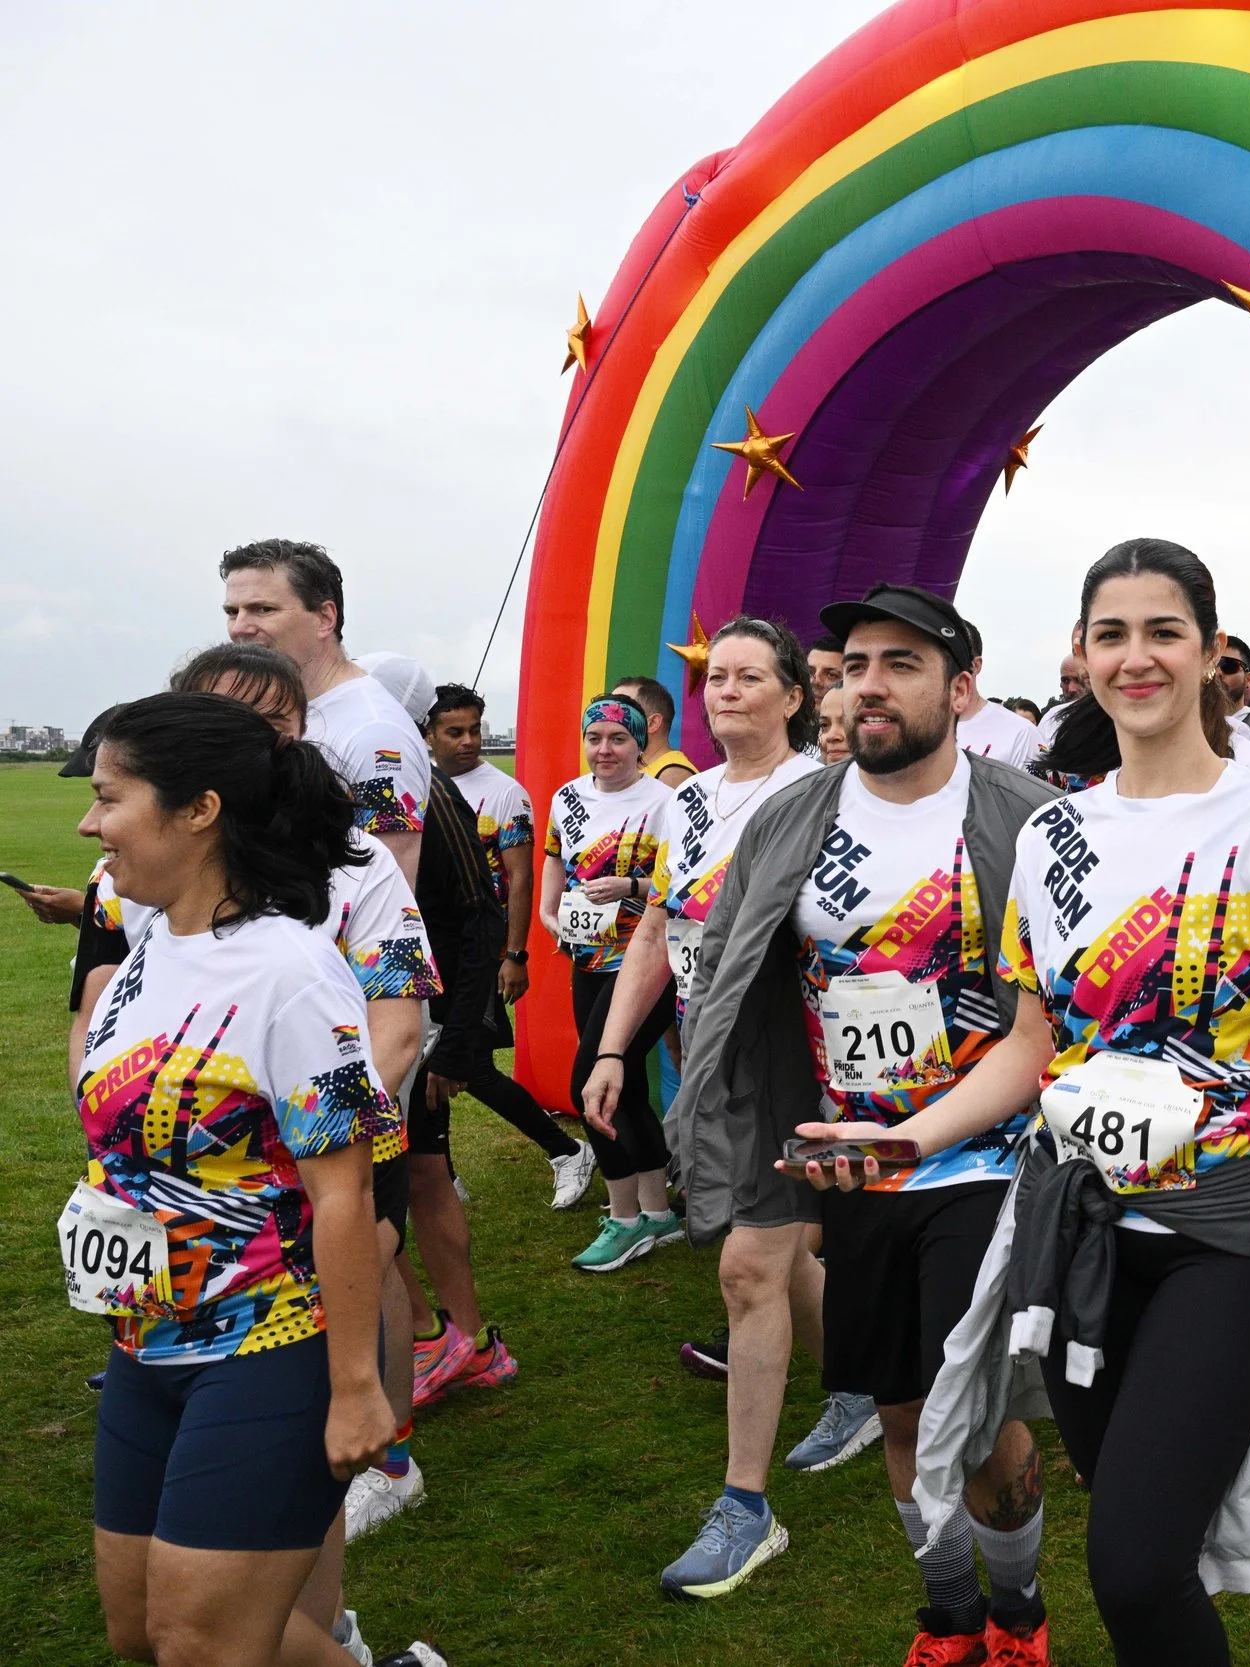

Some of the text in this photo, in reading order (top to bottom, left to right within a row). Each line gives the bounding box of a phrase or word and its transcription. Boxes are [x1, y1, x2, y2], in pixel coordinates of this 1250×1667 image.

[558, 786, 591, 827] PRIDE
[677, 785, 715, 839] PRIDE
[1057, 796, 1085, 827] DUBLIN
[561, 814, 585, 845] RUN
[584, 829, 620, 866] PRIDE
[1031, 804, 1100, 886] PRIDE
[681, 825, 707, 879] RUN
[816, 896, 847, 922] 2024
[882, 867, 953, 948] PRIDE
[1043, 860, 1093, 932] RUN
[570, 910, 604, 931] 837
[1053, 915, 1070, 943] 2024
[1093, 885, 1174, 975] PRIDE
[908, 1001, 935, 1011] QUANTA
[841, 1020, 916, 1062] 210
[92, 1032, 172, 1104] PRIDE
[833, 1062, 856, 1072] PRIDE
[844, 1071, 863, 1080] RUN
[1069, 1105, 1153, 1162] 481
[66, 1224, 154, 1285] 1094
